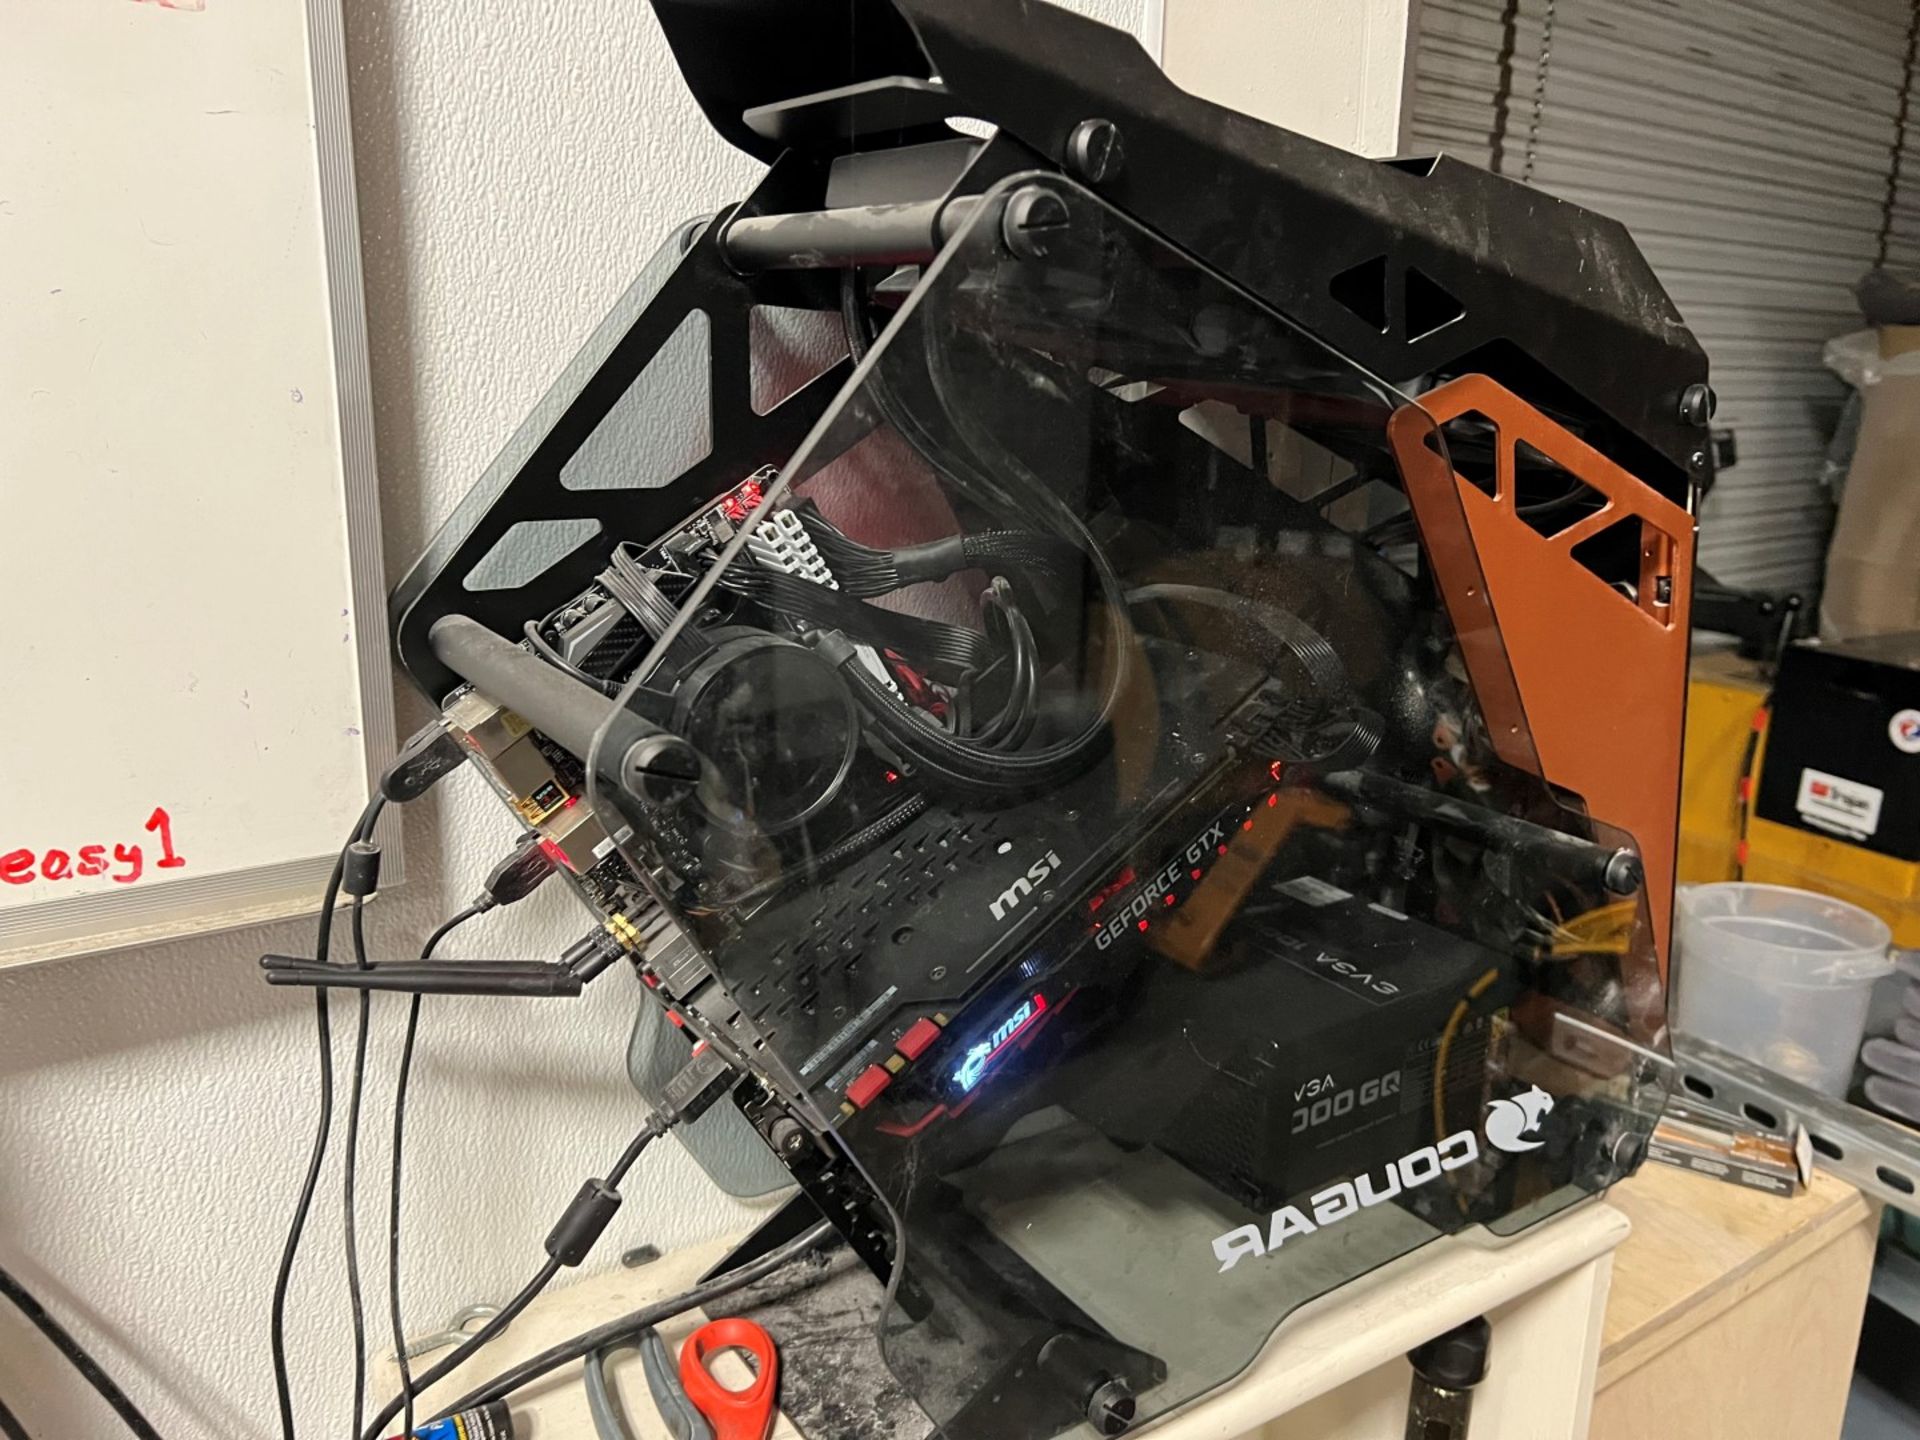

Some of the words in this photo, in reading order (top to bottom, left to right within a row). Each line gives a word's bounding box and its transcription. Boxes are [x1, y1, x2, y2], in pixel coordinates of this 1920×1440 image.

[988, 849, 1062, 921] msi
[1094, 865, 1182, 950] GEFORCE
[1185, 821, 1225, 866] GTX
[991, 1000, 1033, 1049] msi
